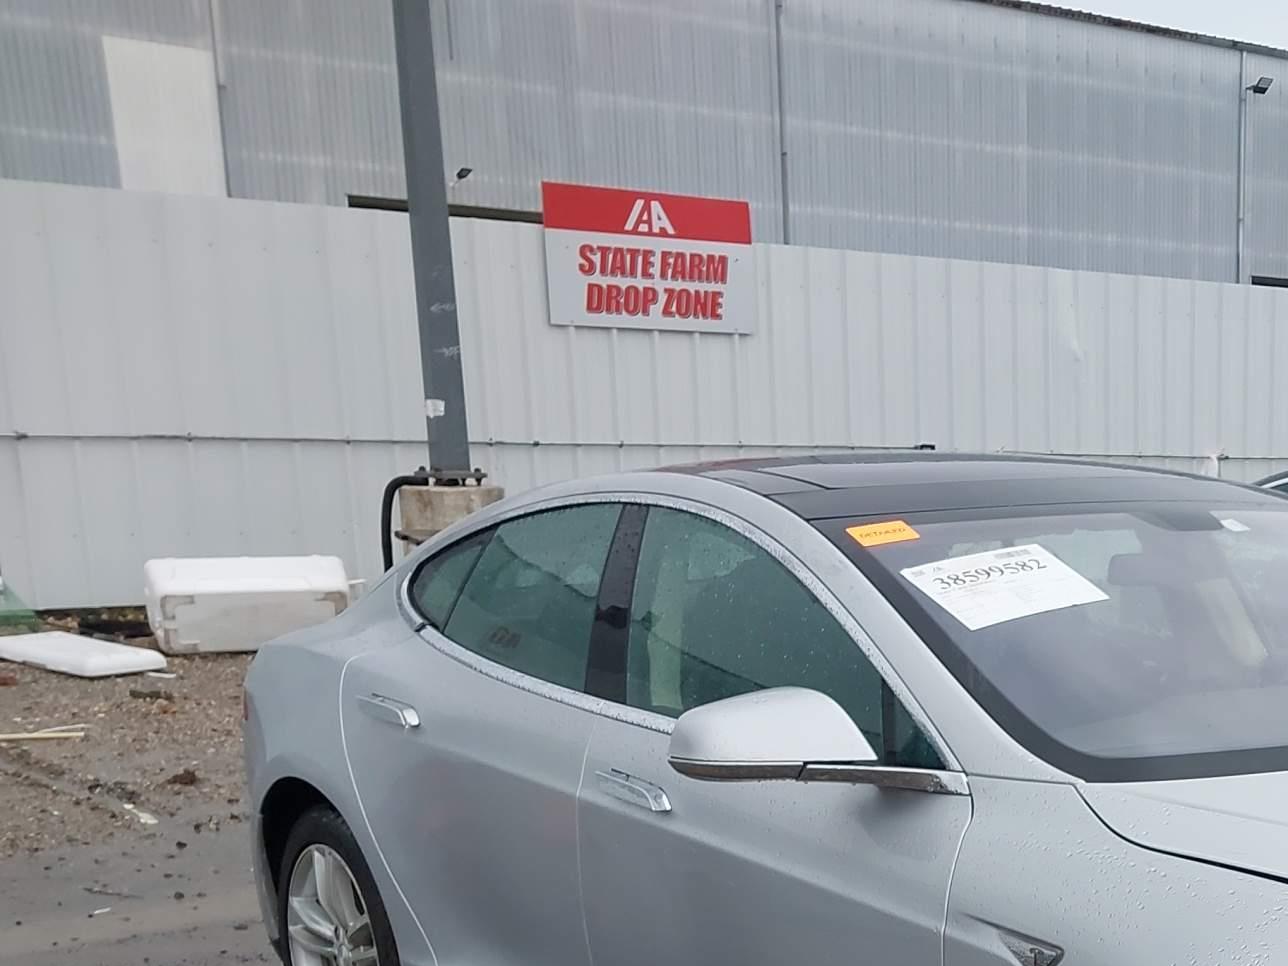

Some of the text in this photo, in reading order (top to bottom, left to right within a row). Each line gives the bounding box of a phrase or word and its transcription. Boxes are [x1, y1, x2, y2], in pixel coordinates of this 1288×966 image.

[578, 243, 729, 285] STATE FARM
[586, 282, 723, 321] DROP ZONE
[932, 558, 1047, 590] 38599582
